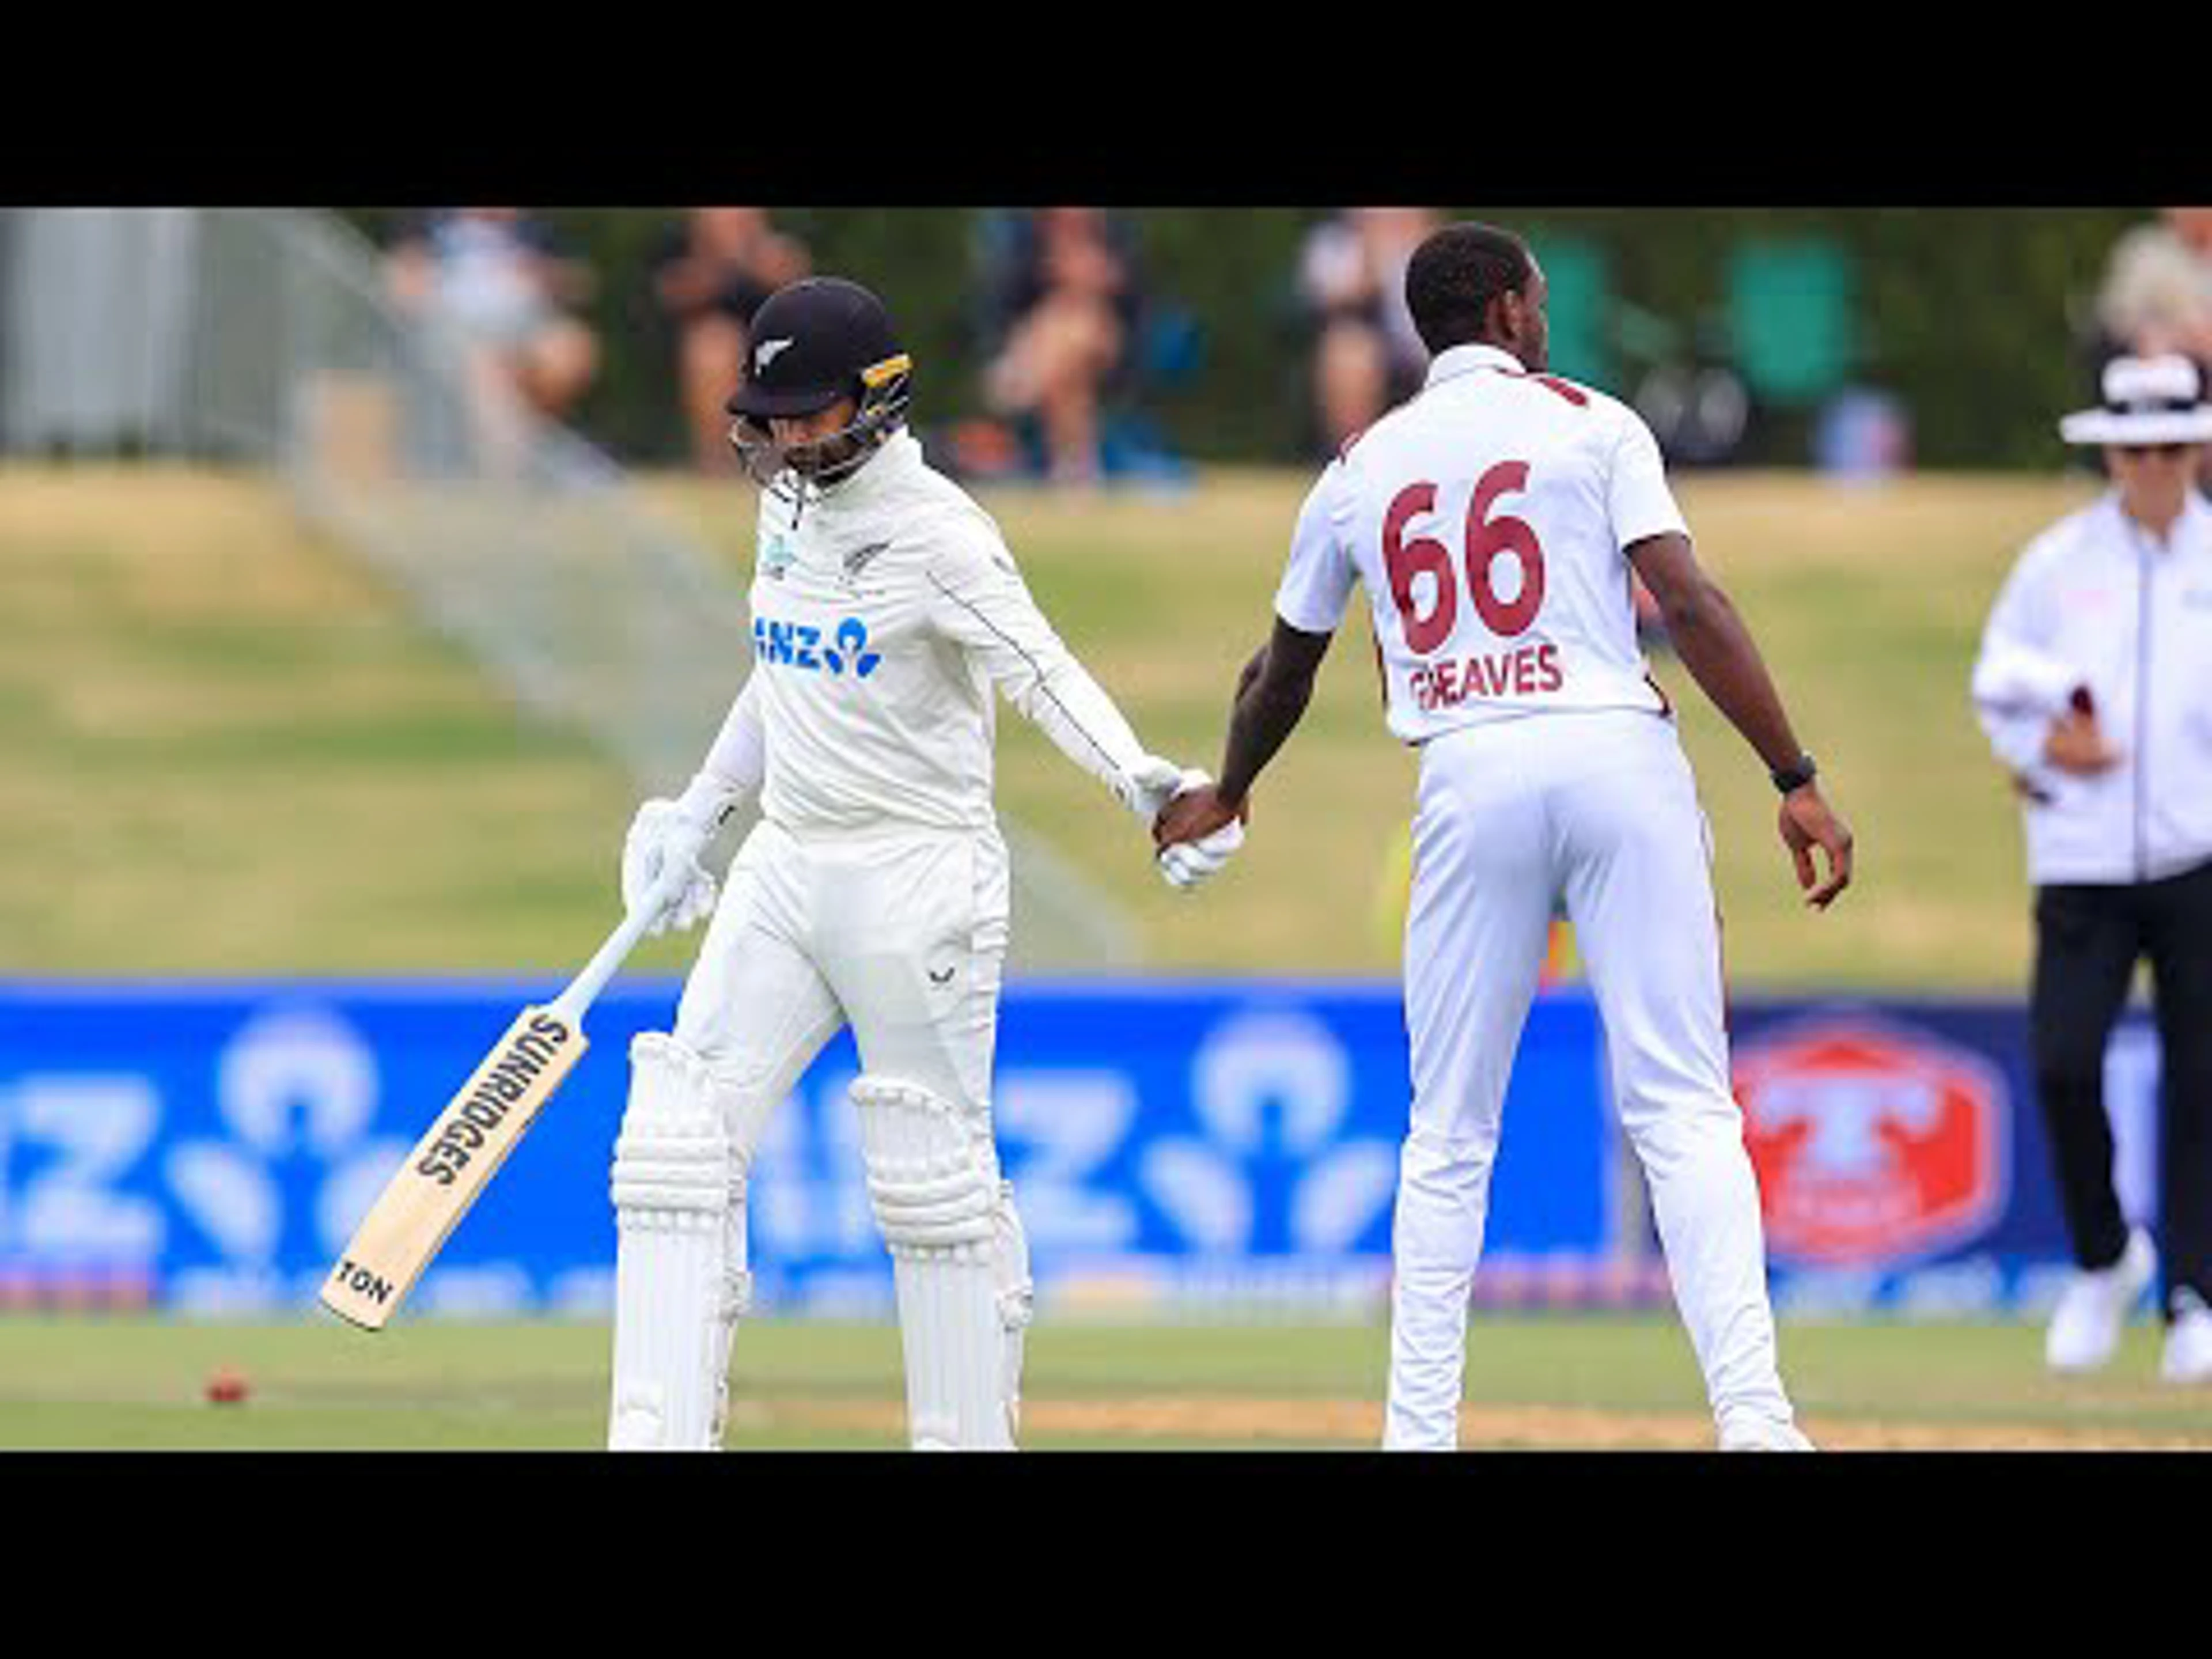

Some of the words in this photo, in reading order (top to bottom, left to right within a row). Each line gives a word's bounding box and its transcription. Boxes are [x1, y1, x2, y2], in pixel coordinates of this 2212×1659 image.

[1382, 460, 1545, 654] 66
[418, 1014, 569, 1185] SUNRIDGES
[336, 1262, 393, 1304] TON
